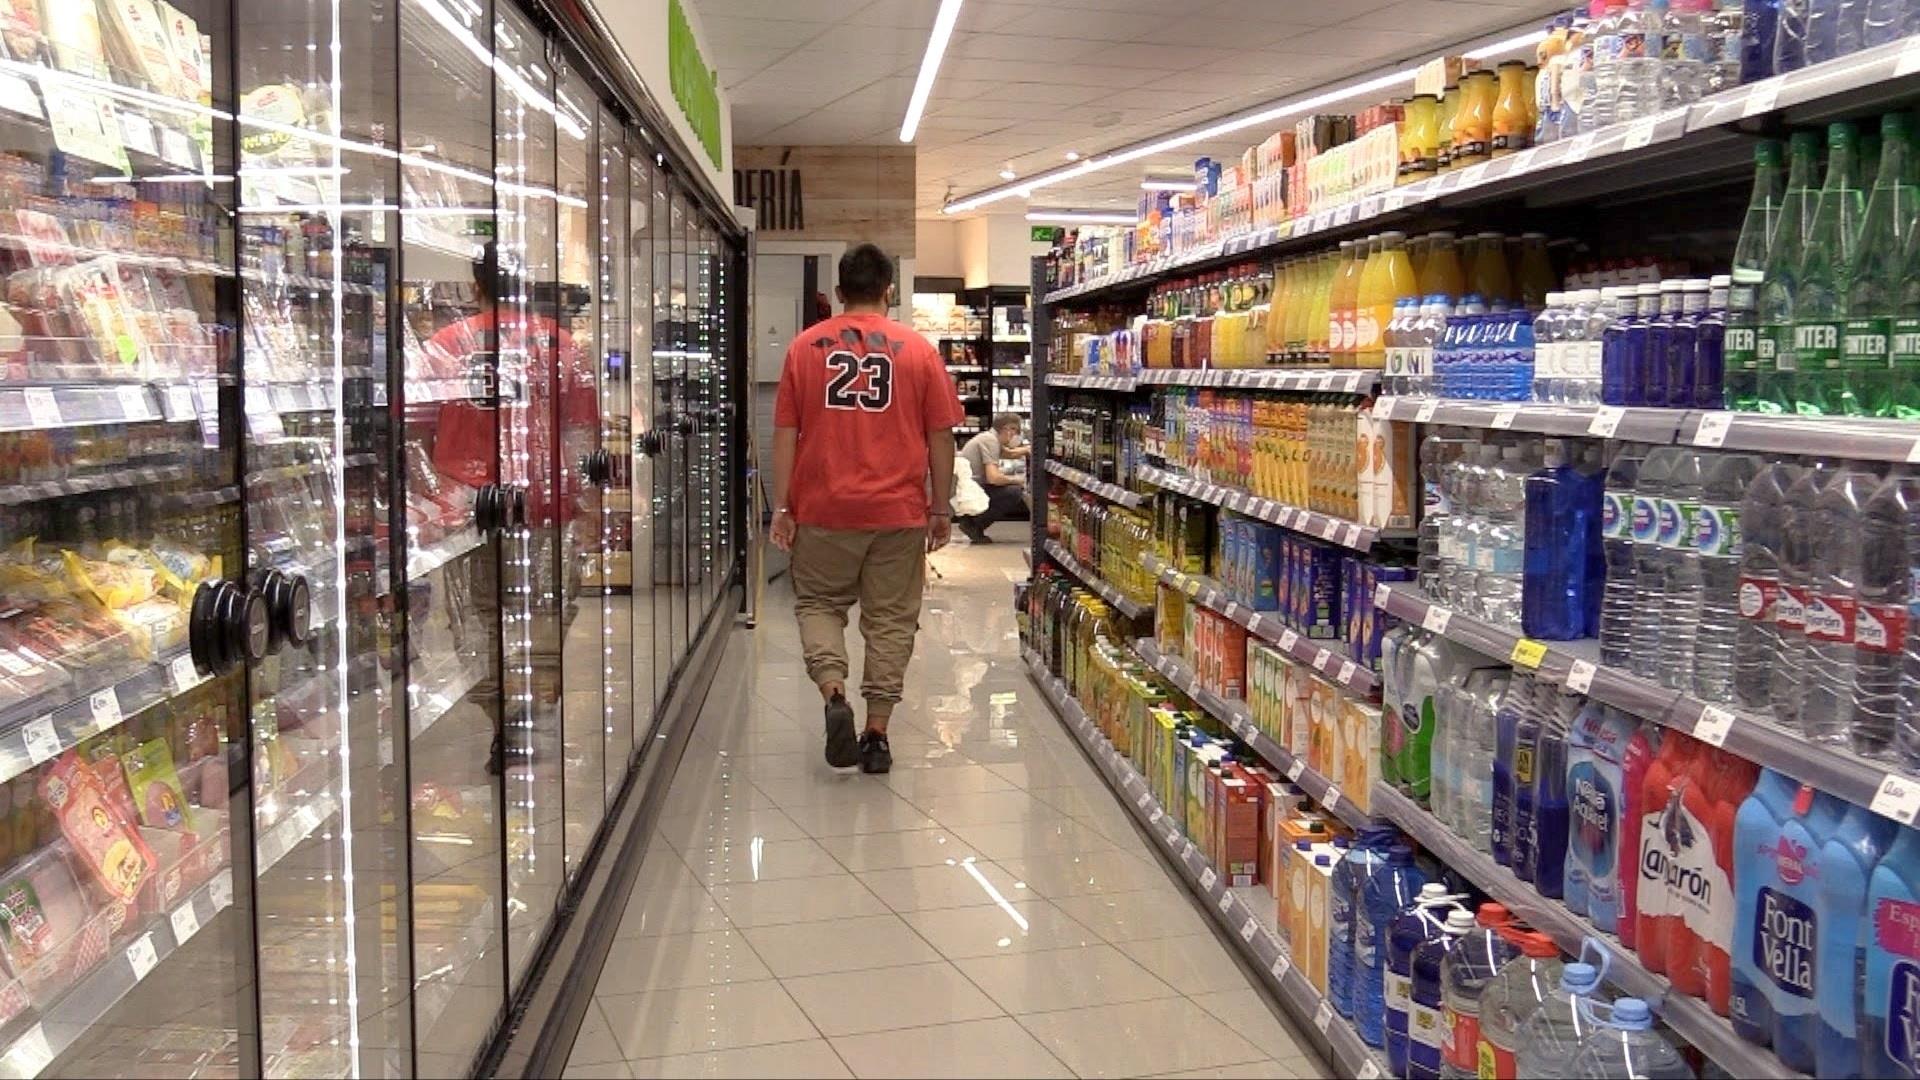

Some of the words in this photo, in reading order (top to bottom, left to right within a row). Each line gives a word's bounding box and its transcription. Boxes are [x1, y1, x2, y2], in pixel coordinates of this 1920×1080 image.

[825, 350, 892, 412] 23
[1762, 893, 1813, 951] Font
[1760, 930, 1813, 990] Vella
